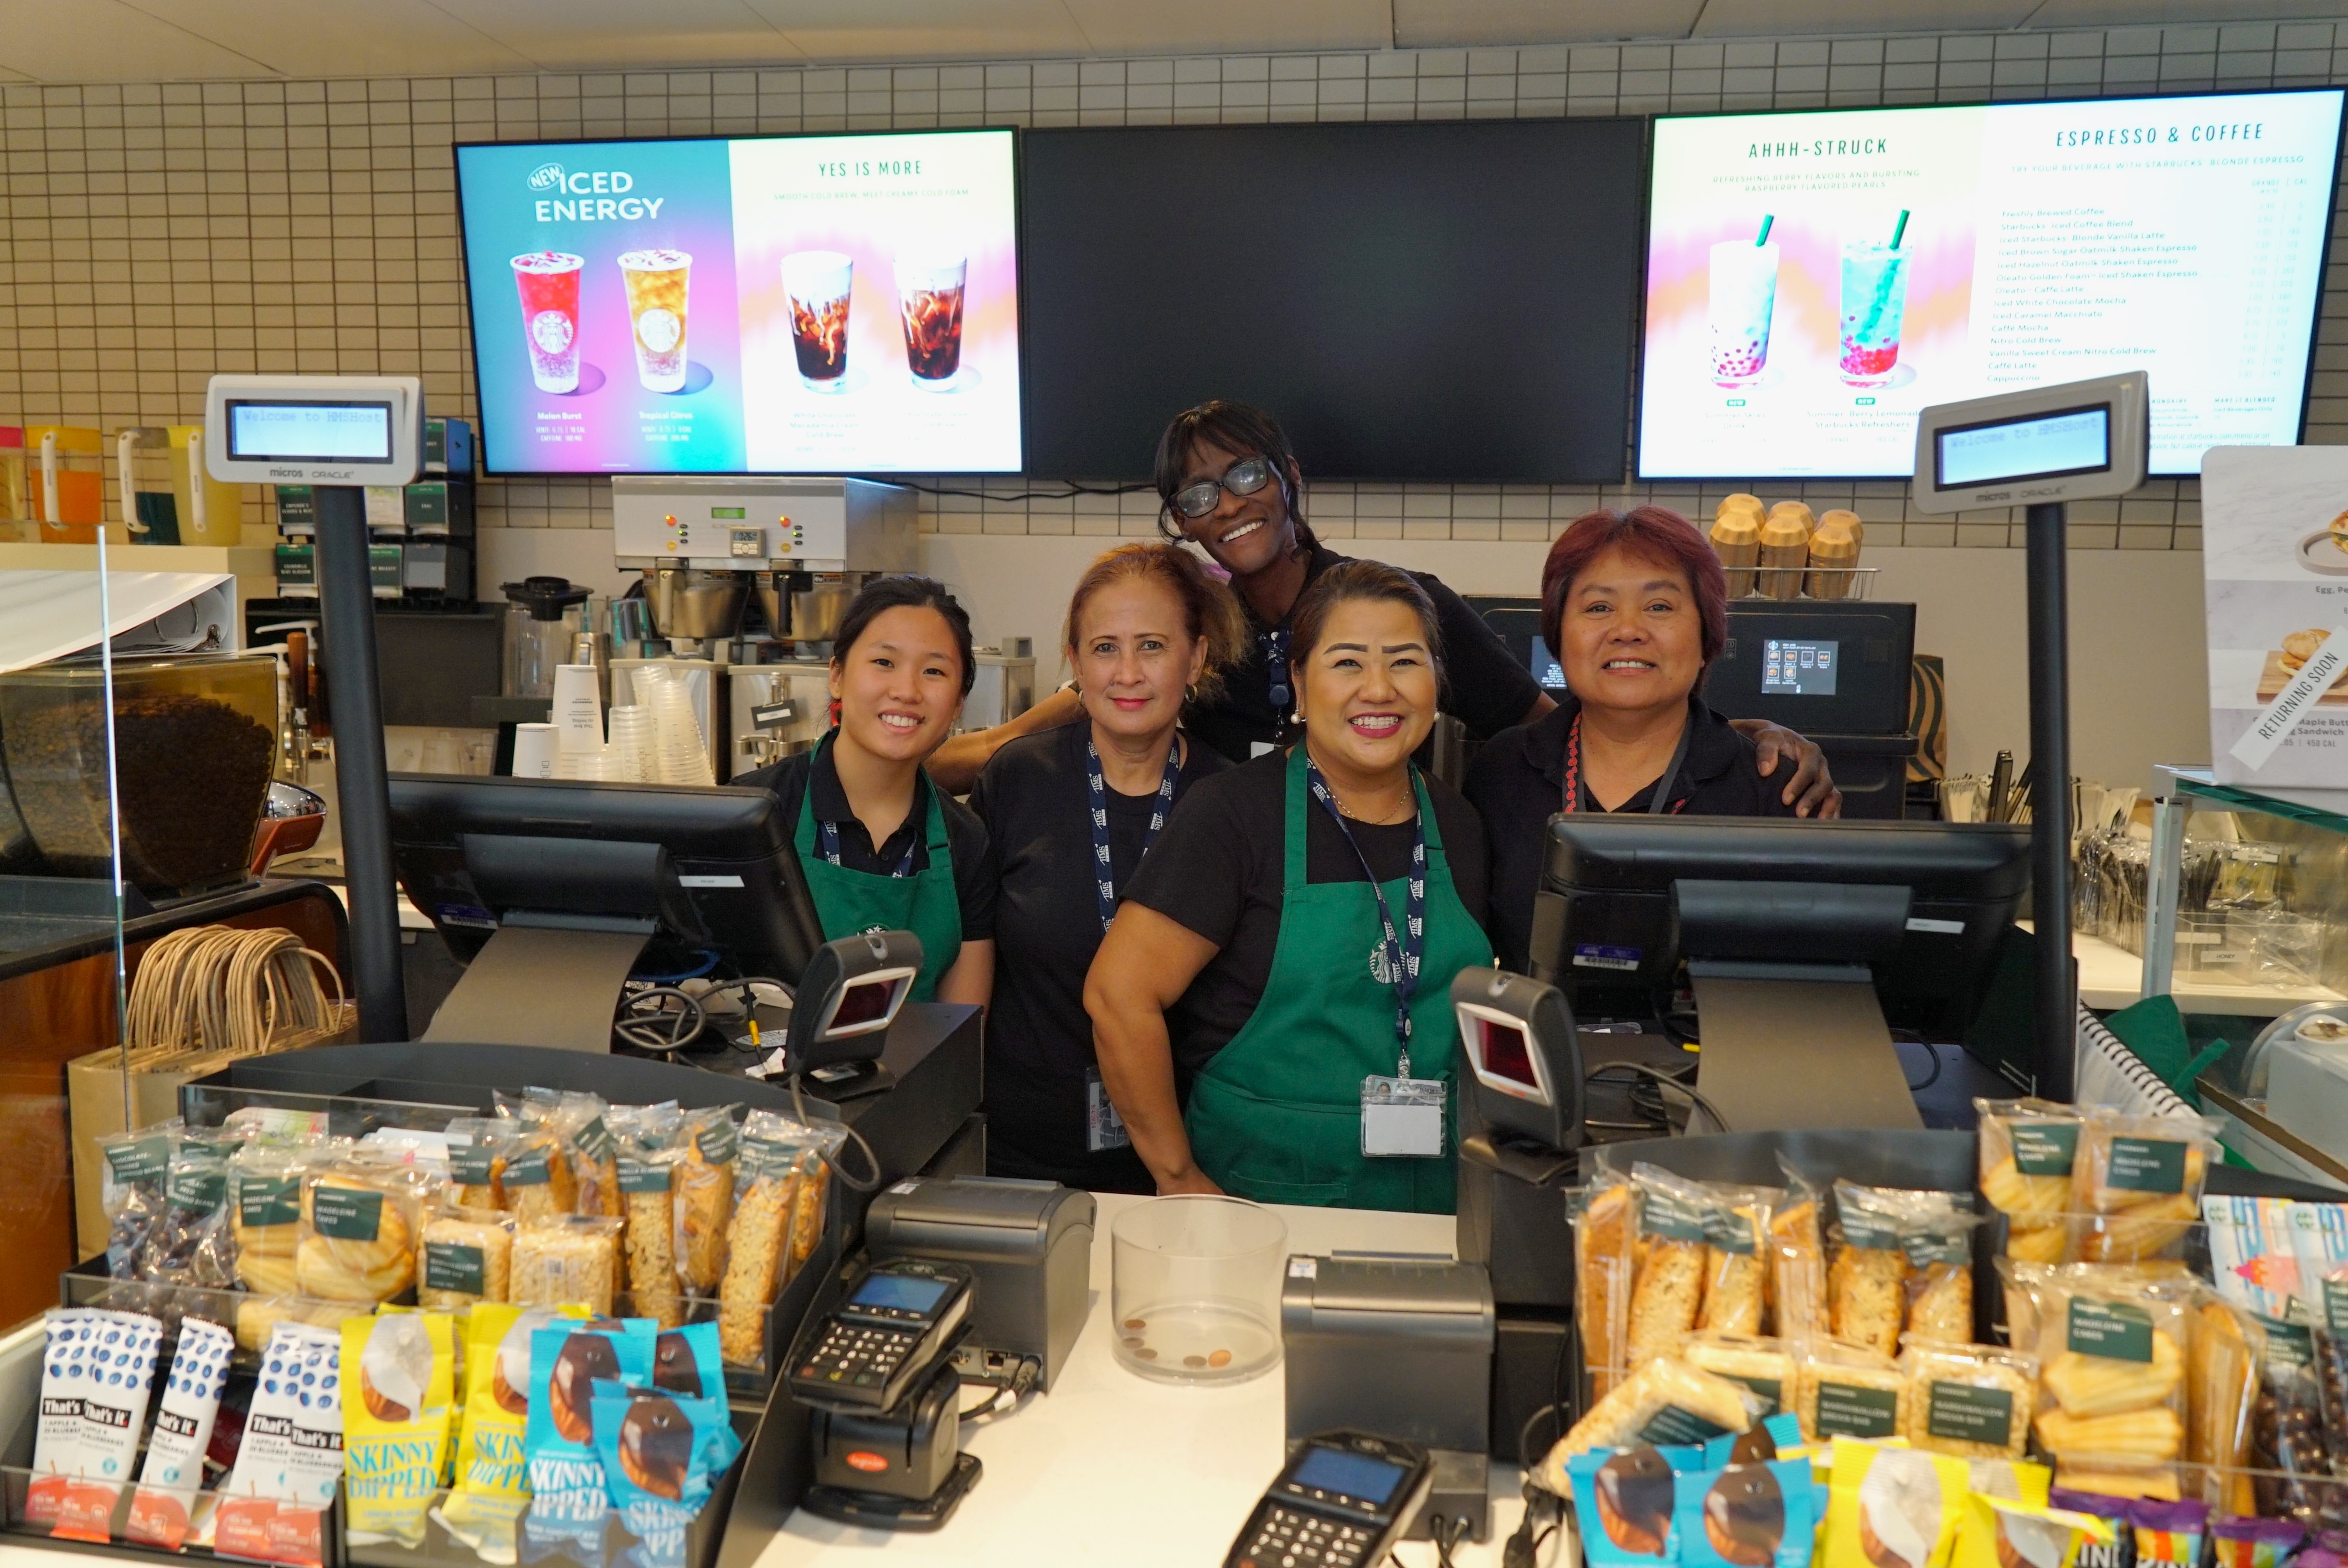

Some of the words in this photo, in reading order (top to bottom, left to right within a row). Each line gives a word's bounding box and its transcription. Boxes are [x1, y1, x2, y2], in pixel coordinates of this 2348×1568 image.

[2057, 128, 2156, 146] ESPRESSO
[2168, 127, 2179, 142] &
[2192, 123, 2263, 141] COFFEE
[1749, 138, 1886, 158] AHHH-STRUCK
[819, 163, 846, 176] YES
[856, 162, 869, 176] IS
[879, 161, 921, 175] MORE
[2253, 156, 2304, 164] ESPRESSO
[531, 166, 559, 187] NEW
[559, 172, 633, 194] ICED
[535, 198, 664, 221] ENERGY
[2138, 257, 2178, 266] Espresso
[244, 411, 296, 421] Welcome
[306, 412, 320, 421] to
[327, 412, 382, 423] HMSHost
[639, 411, 668, 420] Tropical
[1950, 431, 2005, 447] Welcome
[2015, 429, 2030, 438] to
[270, 467, 302, 478] micros
[1976, 491, 2010, 502] micros
[2258, 681, 2313, 740] RETURNING
[2308, 652, 2339, 683] SOON
[1163, 778, 1172, 797] HMS
[1093, 810, 1103, 829] HMS
[1154, 811, 1163, 831] HMS
[1096, 846, 1106, 865] HMS
[1100, 882, 1110, 902] HMS
[1410, 880, 1419, 901] HMS
[1409, 918, 1418, 939] HMS
[1407, 956, 1415, 978] HMS
[44, 1400, 81, 1414] That's
[85, 1403, 113, 1424] That's
[253, 1415, 291, 1436] That's
[292, 1427, 327, 1448] That's
[349, 1440, 437, 1473] SKINNY
[349, 1467, 437, 1499] DIPPED
